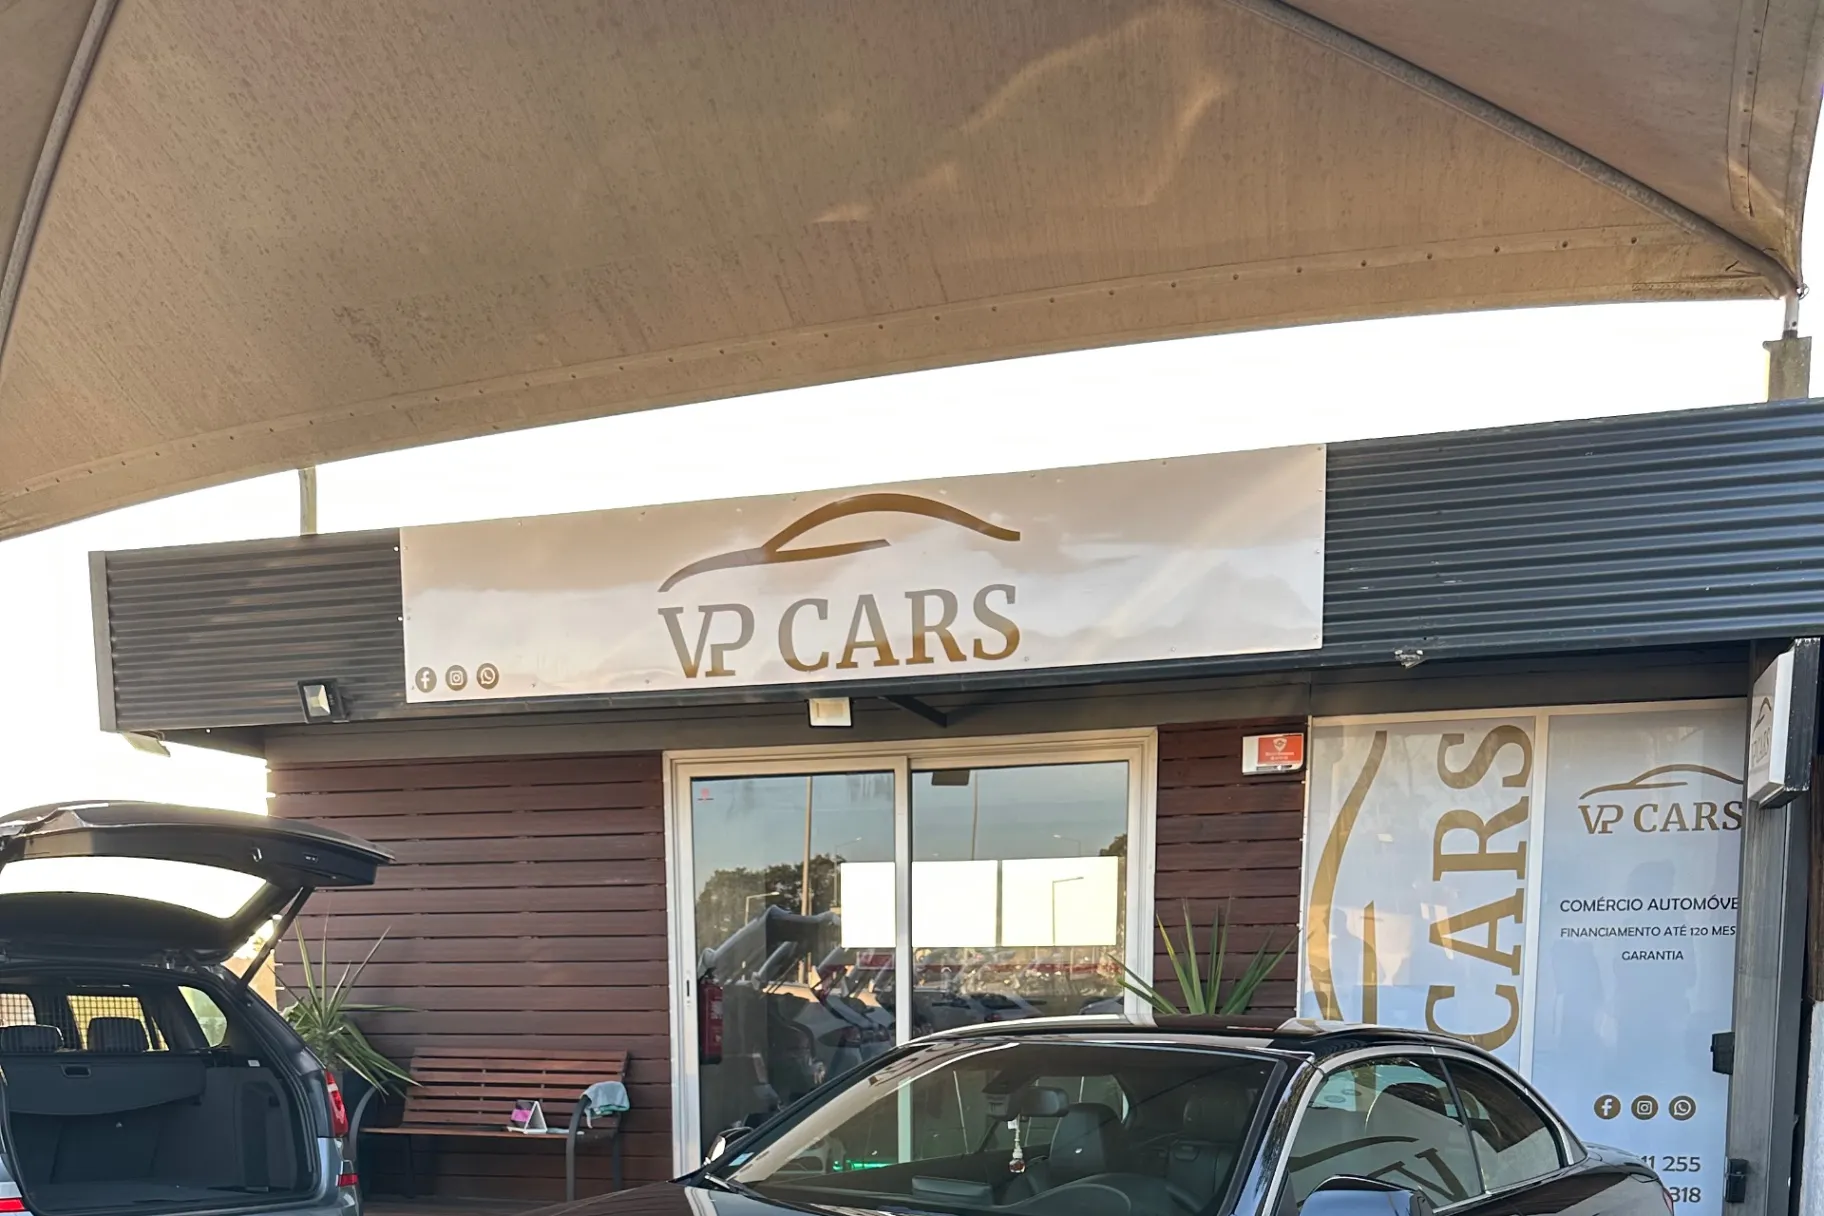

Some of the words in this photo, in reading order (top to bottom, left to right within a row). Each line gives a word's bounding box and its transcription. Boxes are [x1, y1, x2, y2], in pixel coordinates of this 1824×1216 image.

[657, 603, 755, 679] VP
[777, 583, 1021, 673] CARS
[1578, 804, 1624, 834] VP
[1633, 801, 1743, 833] CARS
[1424, 723, 1534, 1053] CARS
[1560, 896, 1643, 912] COMÉRCIO
[1560, 926, 1661, 937] FINANCIAMENTO
[1663, 924, 1687, 936] ATÉ
[1690, 927, 1709, 936] 120
[1621, 950, 1684, 961] GARANTIA
[1662, 1155, 1701, 1172] 255
